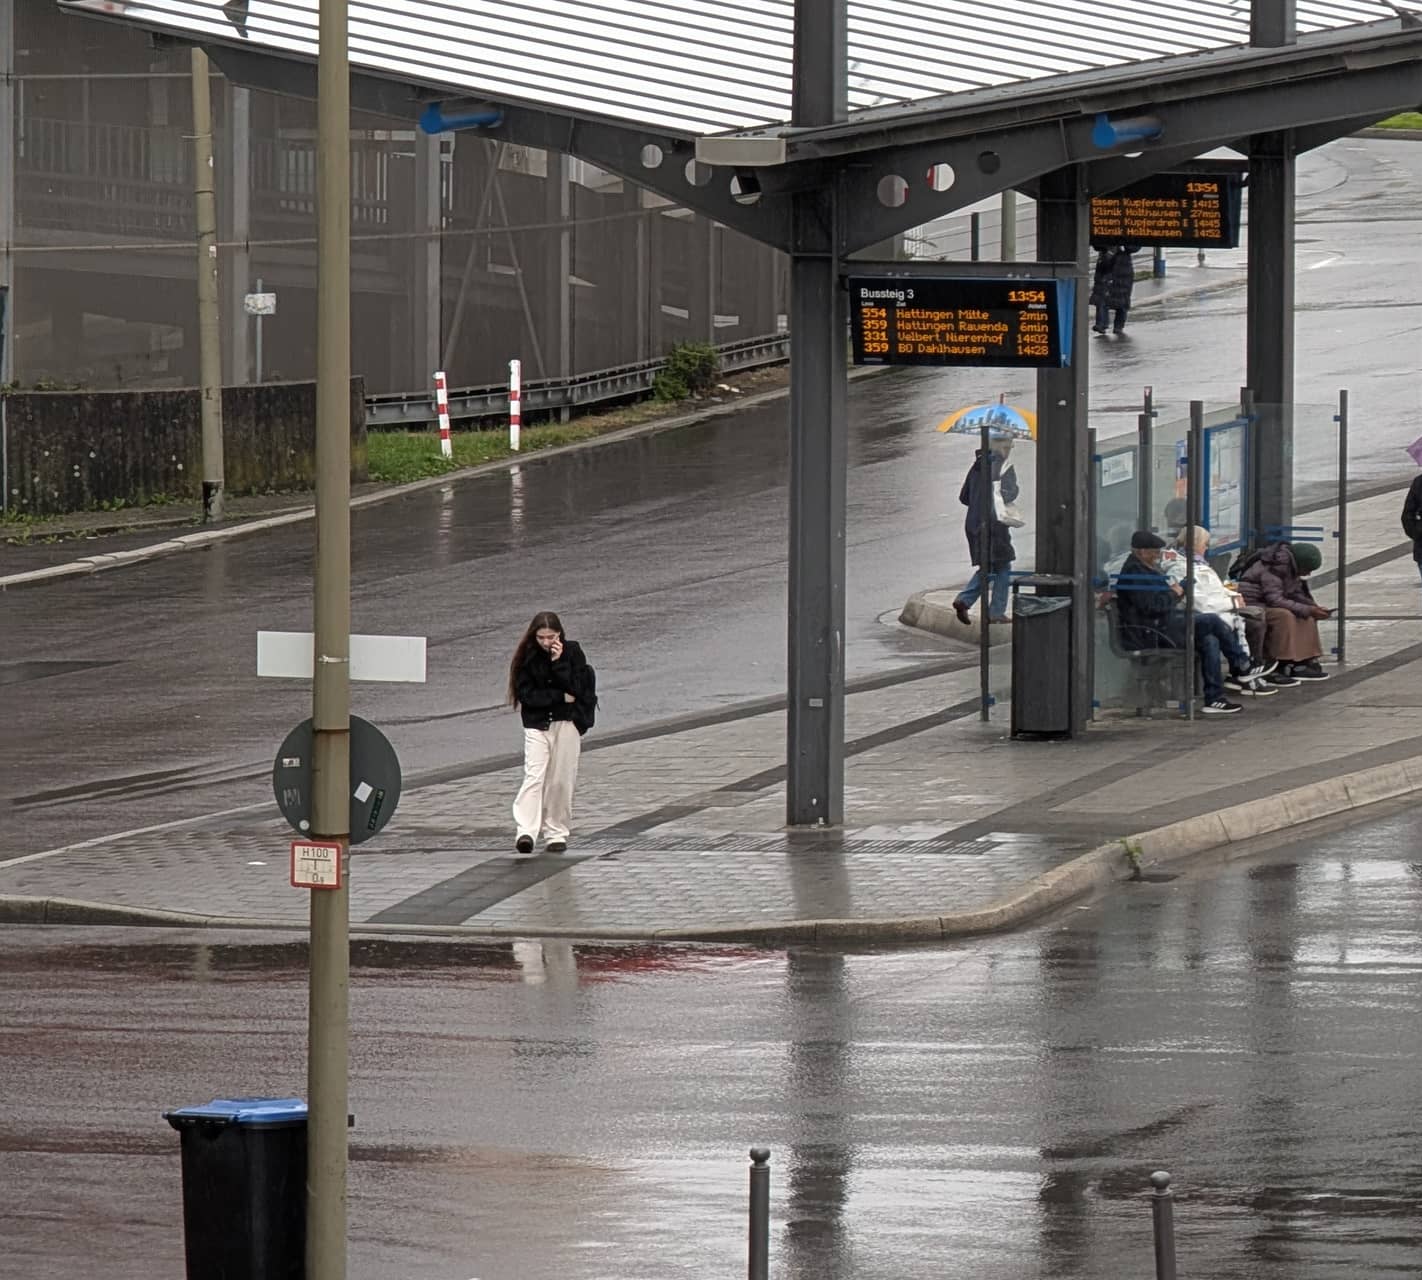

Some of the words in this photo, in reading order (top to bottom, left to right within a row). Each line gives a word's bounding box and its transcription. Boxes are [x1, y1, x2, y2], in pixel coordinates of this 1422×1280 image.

[1187, 183, 1217, 192] 13:54
[1092, 197, 1120, 206] Essen
[1123, 198, 1179, 208] Kupferdreh
[1093, 207, 1121, 216] Klinik
[1125, 208, 1181, 217] Holthausen
[1093, 216, 1120, 226] Essen
[1124, 218, 1180, 228] Kupferdreh
[1094, 226, 1123, 236] Klinik
[1127, 228, 1182, 237] Holthausen
[860, 288, 905, 301] Bussteig
[906, 289, 914, 299] 3
[1008, 290, 1046, 302] 13:54
[862, 308, 887, 318] 554
[896, 308, 954, 321] Hattingen
[958, 310, 989, 320] Mitte
[1019, 311, 1048, 321] 2min
[863, 319, 888, 330] 359
[897, 320, 954, 333] Hattingen
[959, 321, 1009, 332] Rauenda
[1020, 322, 1048, 333] 6min
[863, 331, 888, 341] 331
[945, 332, 1003, 345] Nierenhof
[1017, 334, 1048, 344] 14:02
[864, 343, 889, 353] 359
[918, 343, 986, 355] Dahlhausen
[1017, 345, 1048, 356] 14:28
